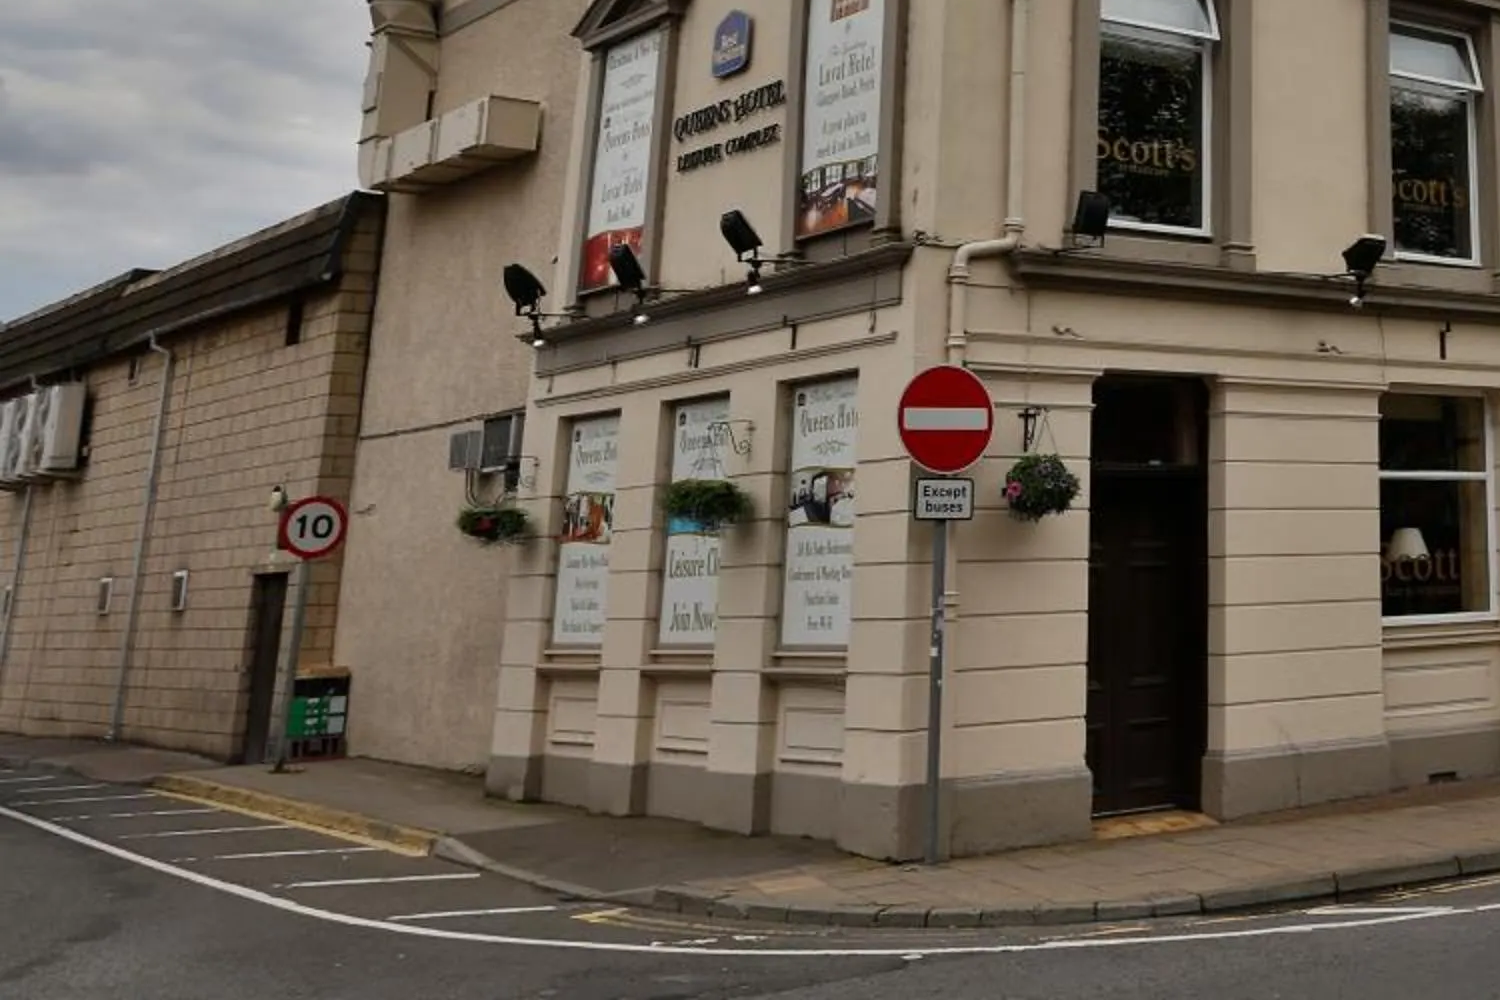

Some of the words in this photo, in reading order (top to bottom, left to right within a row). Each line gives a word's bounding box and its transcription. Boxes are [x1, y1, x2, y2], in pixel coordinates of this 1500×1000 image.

[674, 99, 732, 143] QUEENS
[733, 80, 786, 122] HOTEL
[1096, 125, 1196, 171] Scott's
[1393, 176, 1467, 208] cott's
[922, 485, 967, 500] Except
[925, 501, 963, 512] buses
[296, 514, 334, 539] 10
[668, 549, 704, 580] Leisure
[669, 602, 692, 633] Join
